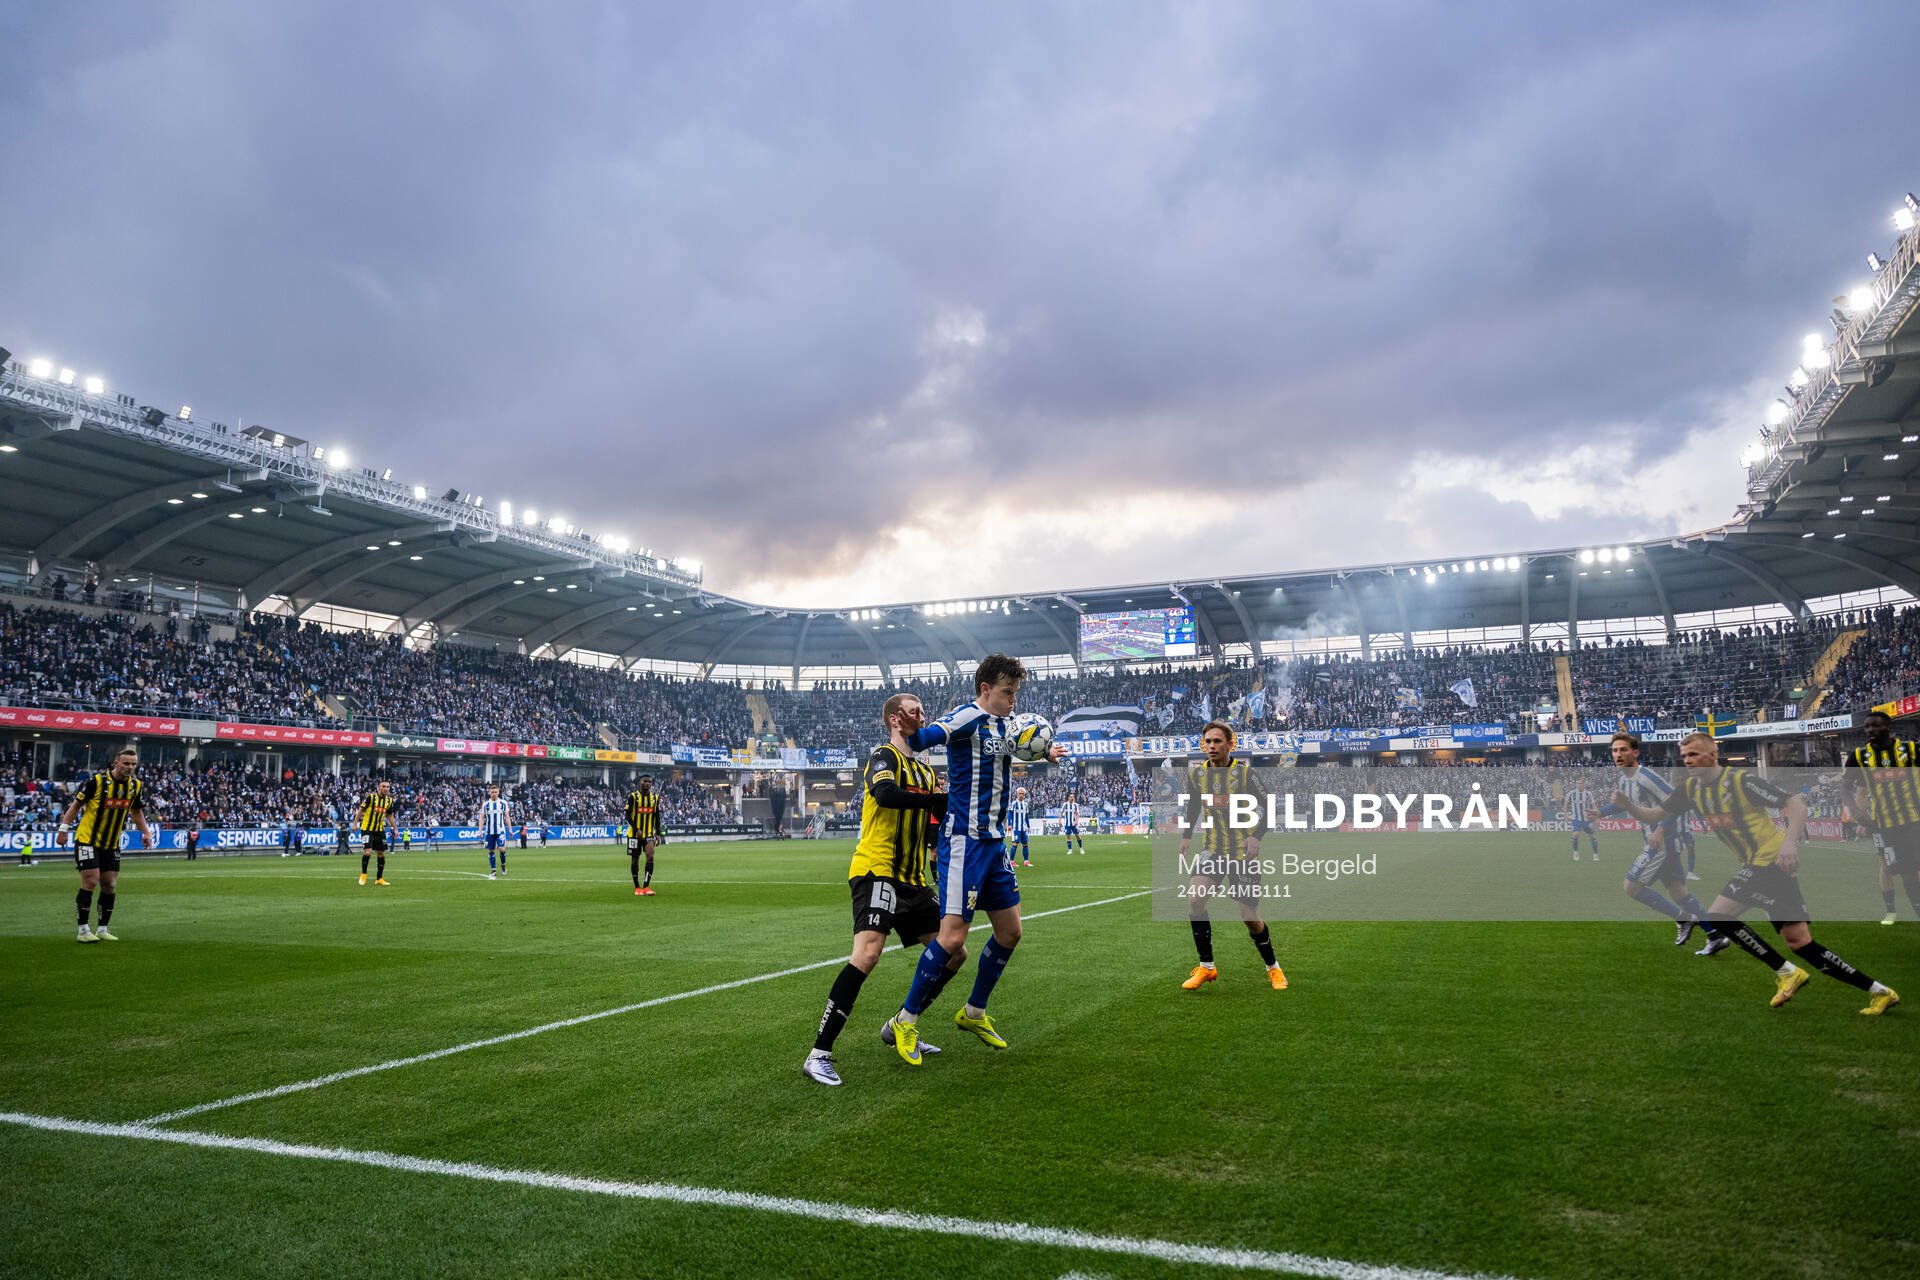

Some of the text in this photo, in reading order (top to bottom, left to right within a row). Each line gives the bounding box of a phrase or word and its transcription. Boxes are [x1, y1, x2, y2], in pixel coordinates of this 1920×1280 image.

[1586, 718, 1656, 735] WISE MEN
[1413, 738, 1440, 749] FAT21
[217, 830, 282, 846] SERNEKE
[560, 827, 580, 838] AROS
[581, 826, 609, 838] KAPITAL
[868, 913, 880, 926] 14
